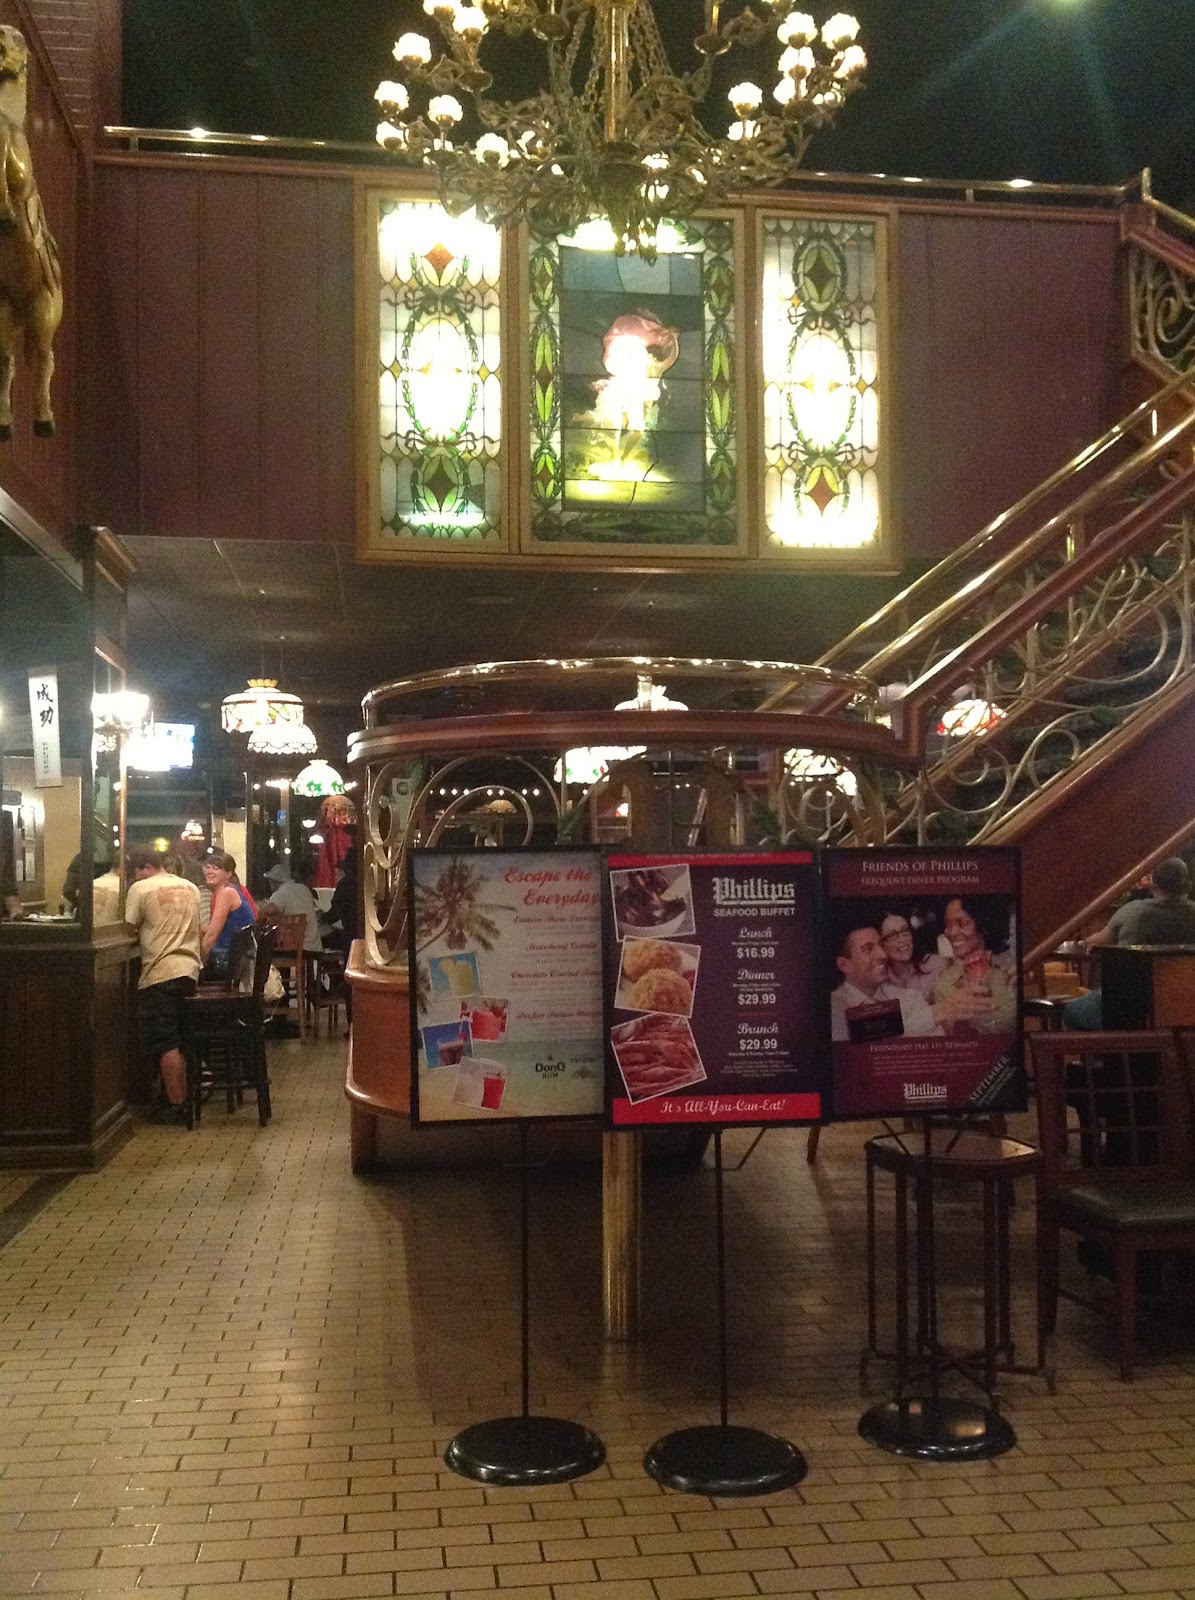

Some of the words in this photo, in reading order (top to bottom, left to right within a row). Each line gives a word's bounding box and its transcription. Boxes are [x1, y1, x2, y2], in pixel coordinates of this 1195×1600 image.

[504, 867, 561, 887] Escape
[566, 867, 593, 881] the
[712, 877, 796, 905] Phillips
[523, 888, 599, 907] Everyday
[713, 908, 758, 917] SEAFOOD
[760, 907, 796, 916] BUFFET
[738, 926, 773, 938] Lunch
[736, 947, 775, 959] $16.99
[737, 968, 776, 980] Dinner
[738, 993, 776, 1005] $29.99
[737, 1022, 779, 1034] Brunch
[739, 1038, 778, 1050] $29.99
[535, 1062, 566, 1073] DonQ
[903, 1083, 947, 1100] Phillips
